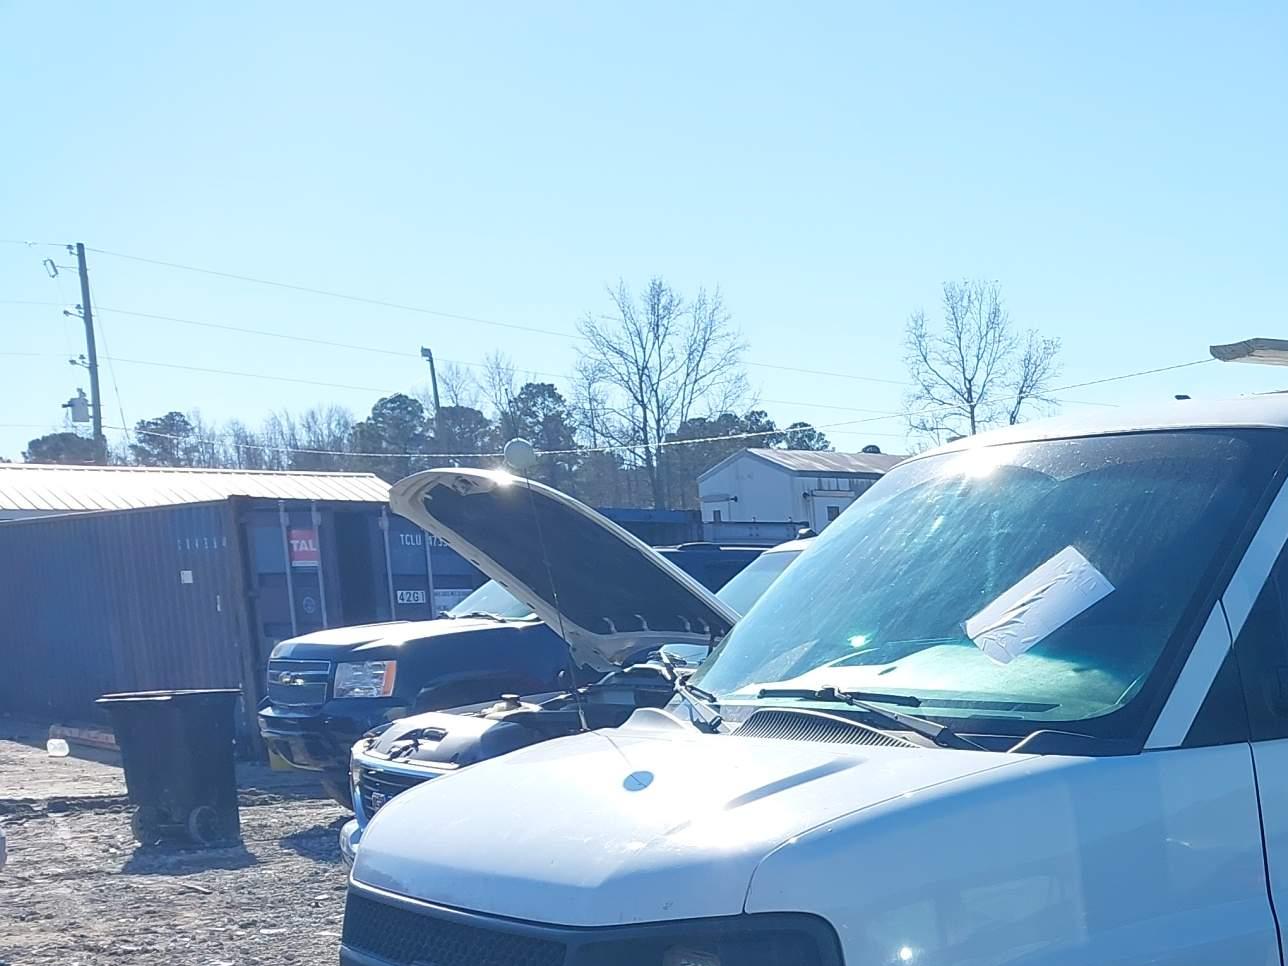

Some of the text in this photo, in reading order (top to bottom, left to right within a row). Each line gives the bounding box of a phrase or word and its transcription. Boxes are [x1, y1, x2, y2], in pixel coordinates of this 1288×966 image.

[290, 540, 317, 552] TAL
[400, 534, 422, 546] TCLU
[400, 592, 425, 603] 42G1
